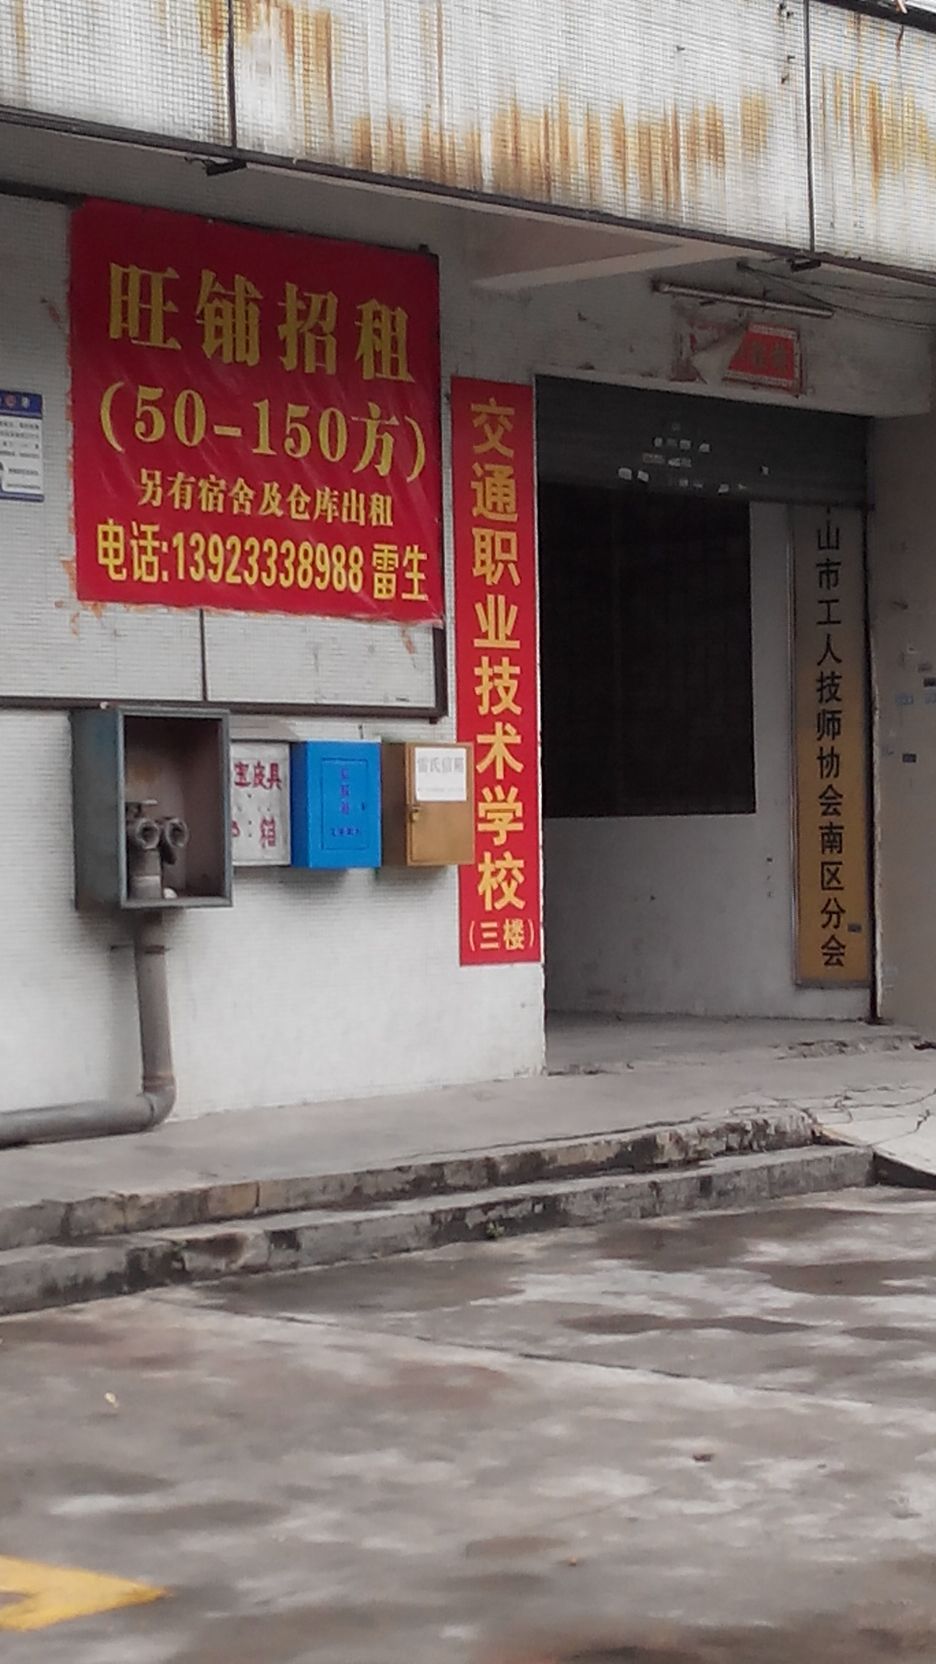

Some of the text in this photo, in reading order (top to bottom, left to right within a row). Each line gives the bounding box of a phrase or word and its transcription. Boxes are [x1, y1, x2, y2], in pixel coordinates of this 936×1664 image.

[109, 263, 415, 383] 旺铺招租
[138, 468, 394, 528] 另有宿舍及仓库出租
[372, 542, 429, 602] 雷生
[471, 398, 526, 912] 交通职业技术学校
[815, 505, 847, 967] 山市工人技师协会南区分会
[469, 918, 534, 952] (三楼)
